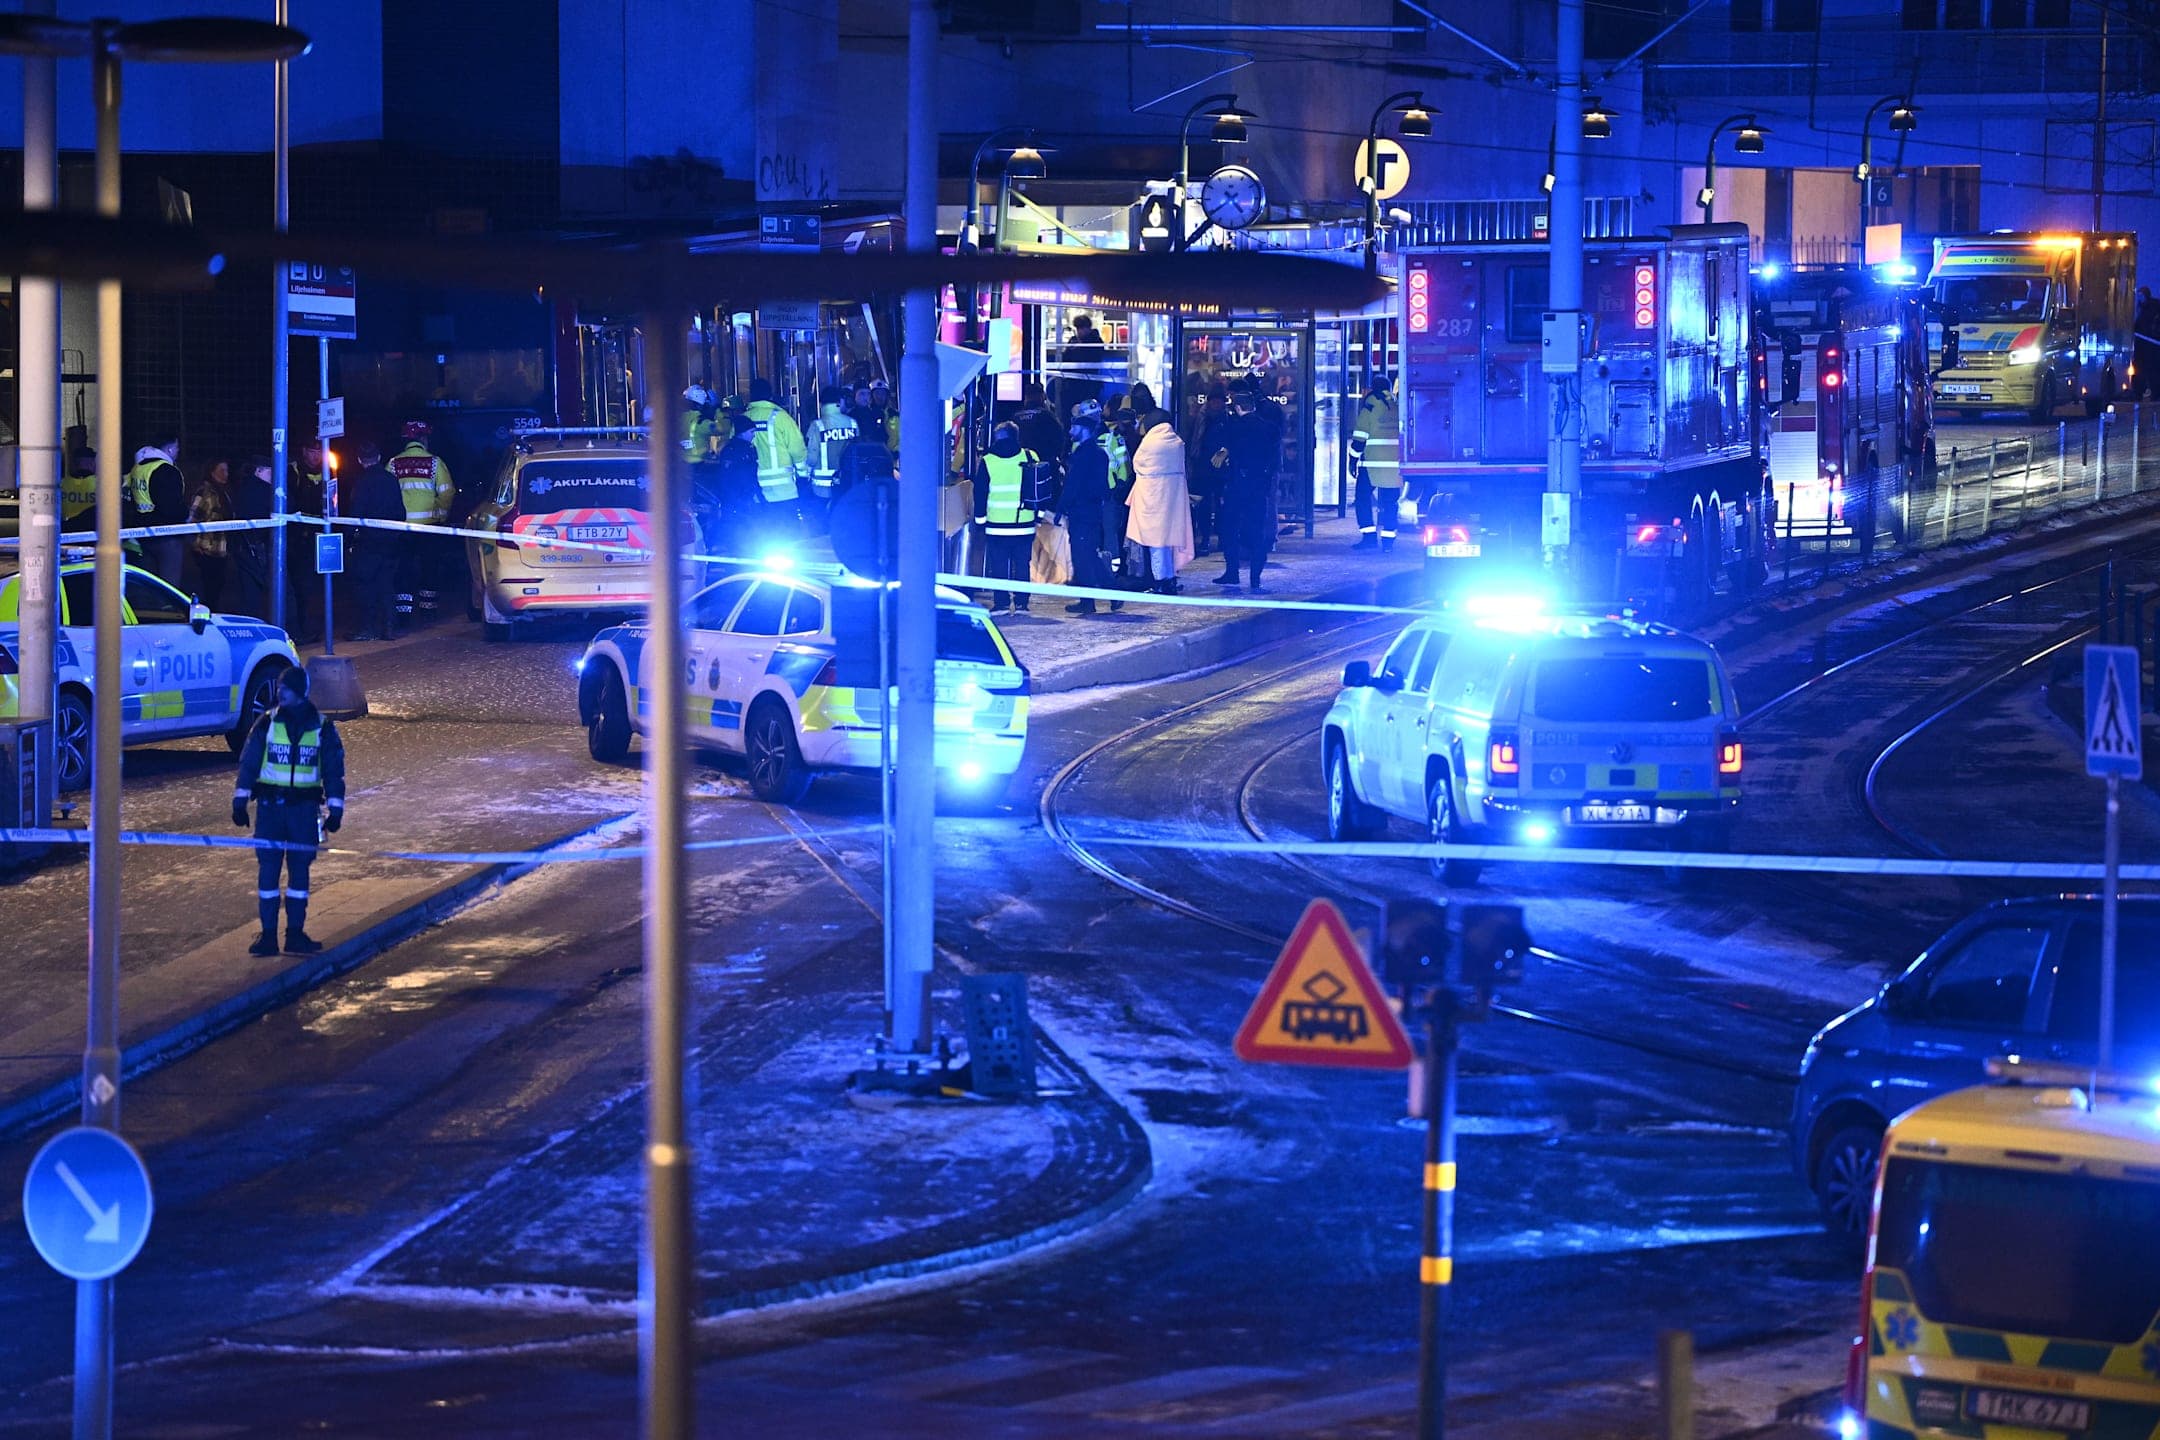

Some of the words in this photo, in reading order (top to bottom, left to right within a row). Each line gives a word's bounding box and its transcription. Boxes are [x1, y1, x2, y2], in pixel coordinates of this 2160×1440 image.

[1877, 186, 1888, 202] 6
[782, 219, 792, 232] T
[312, 264, 323, 280] U
[1437, 318, 1473, 337] 287
[513, 417, 542, 429] 5549
[553, 477, 637, 488] AKUTLÄKARE
[61, 491, 96, 504] POLIS
[576, 527, 598, 539] FTB
[601, 526, 623, 538] 27Y
[159, 651, 215, 683] POLIS
[1536, 733, 1579, 746] POLIS
[276, 754, 289, 764] VA
[1616, 807, 1645, 819] 91A
